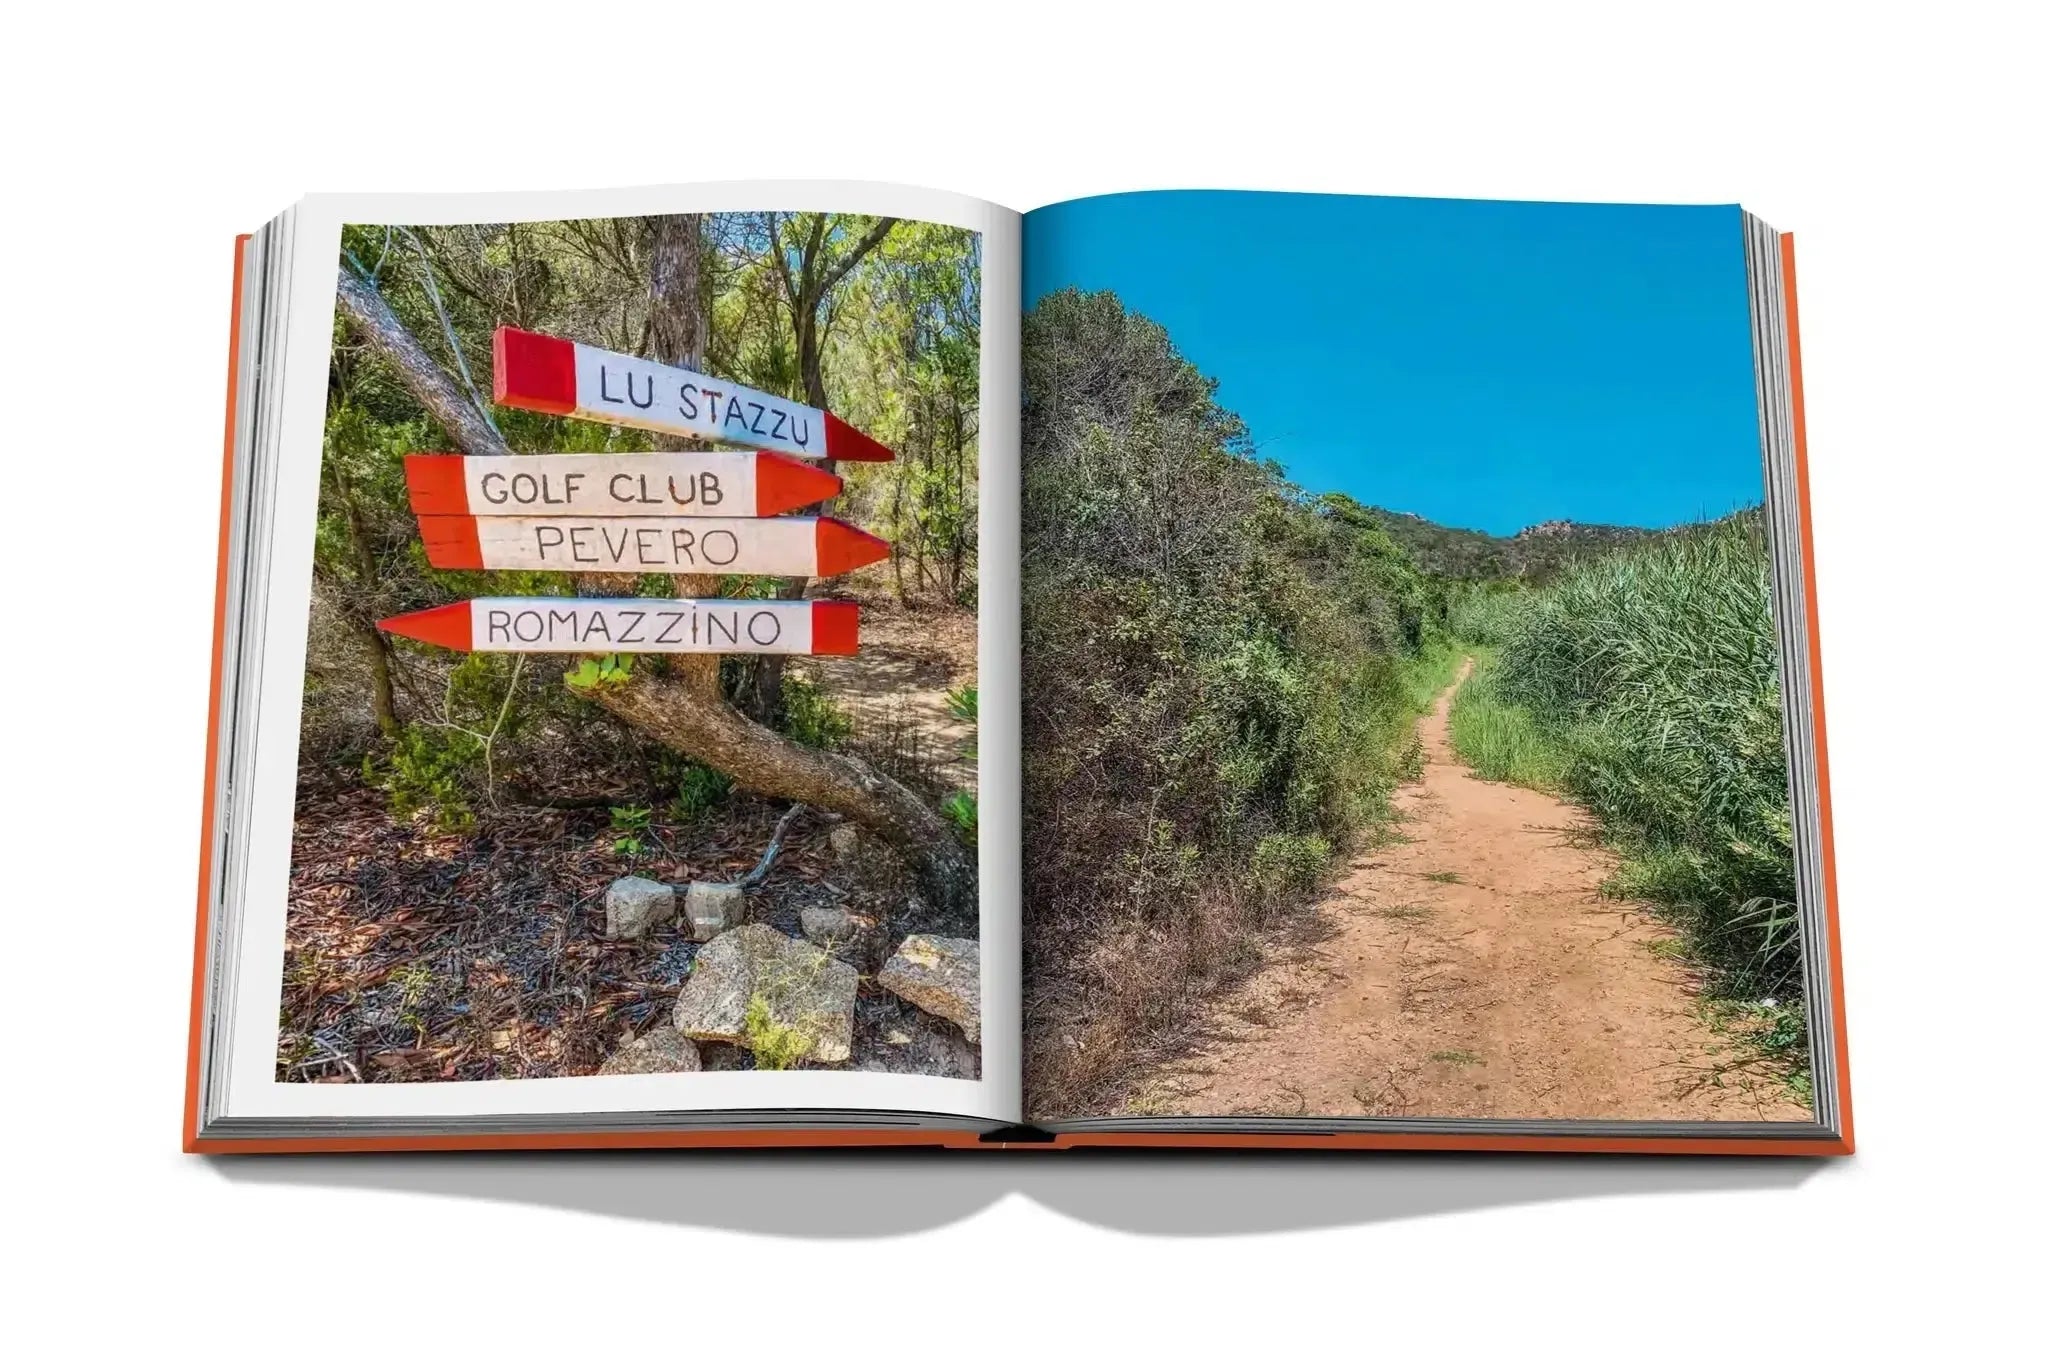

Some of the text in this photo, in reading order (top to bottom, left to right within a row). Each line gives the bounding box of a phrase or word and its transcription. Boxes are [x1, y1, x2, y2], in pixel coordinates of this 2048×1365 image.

[600, 365, 809, 450] LU STAZZU
[481, 472, 724, 505] GOLF CLUB
[535, 526, 739, 565] PEVERO
